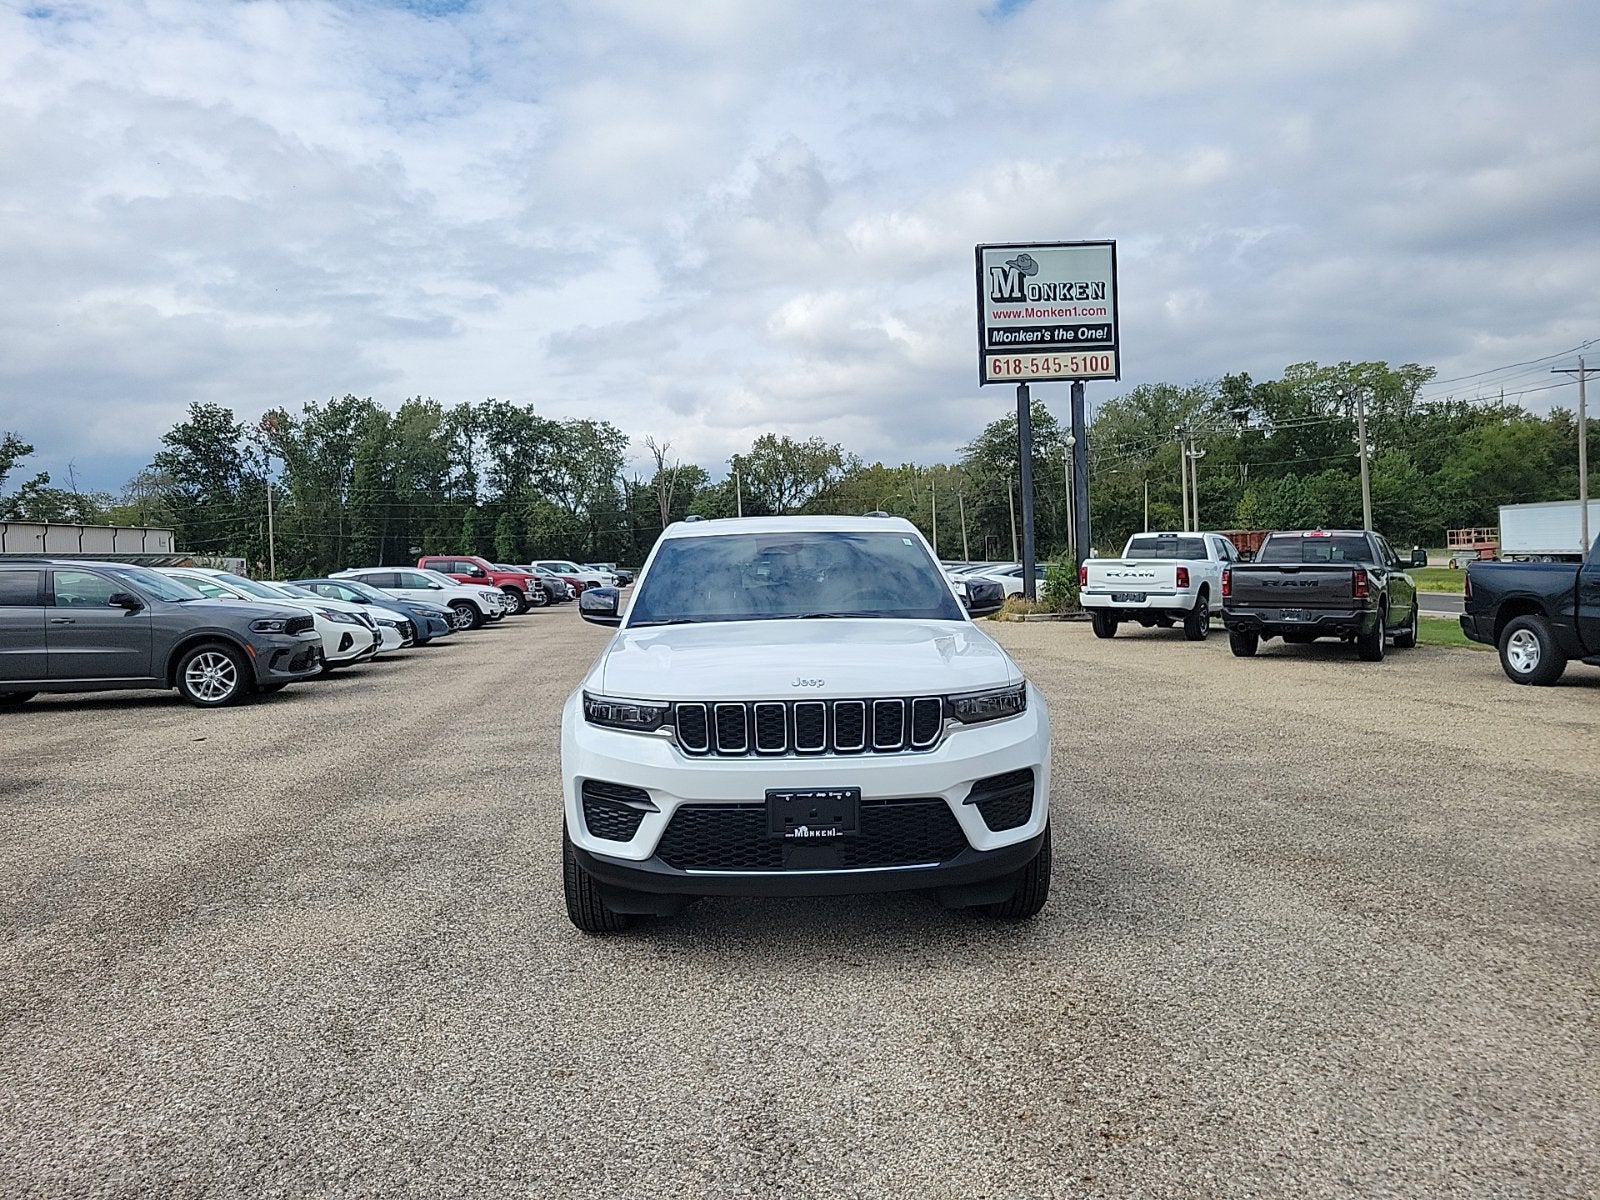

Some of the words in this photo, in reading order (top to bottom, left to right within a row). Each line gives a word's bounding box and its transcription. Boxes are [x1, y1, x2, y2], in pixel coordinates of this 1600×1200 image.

[990, 266, 1106, 303] MONKEN
[992, 306, 1107, 319] www.Monken1.com
[992, 329, 1051, 342] Monken's
[1054, 329, 1075, 340] the
[1078, 327, 1107, 339] One!
[992, 355, 1110, 375] 618-545-5100
[1106, 569, 1155, 577] RAM
[791, 677, 825, 688] Jeep
